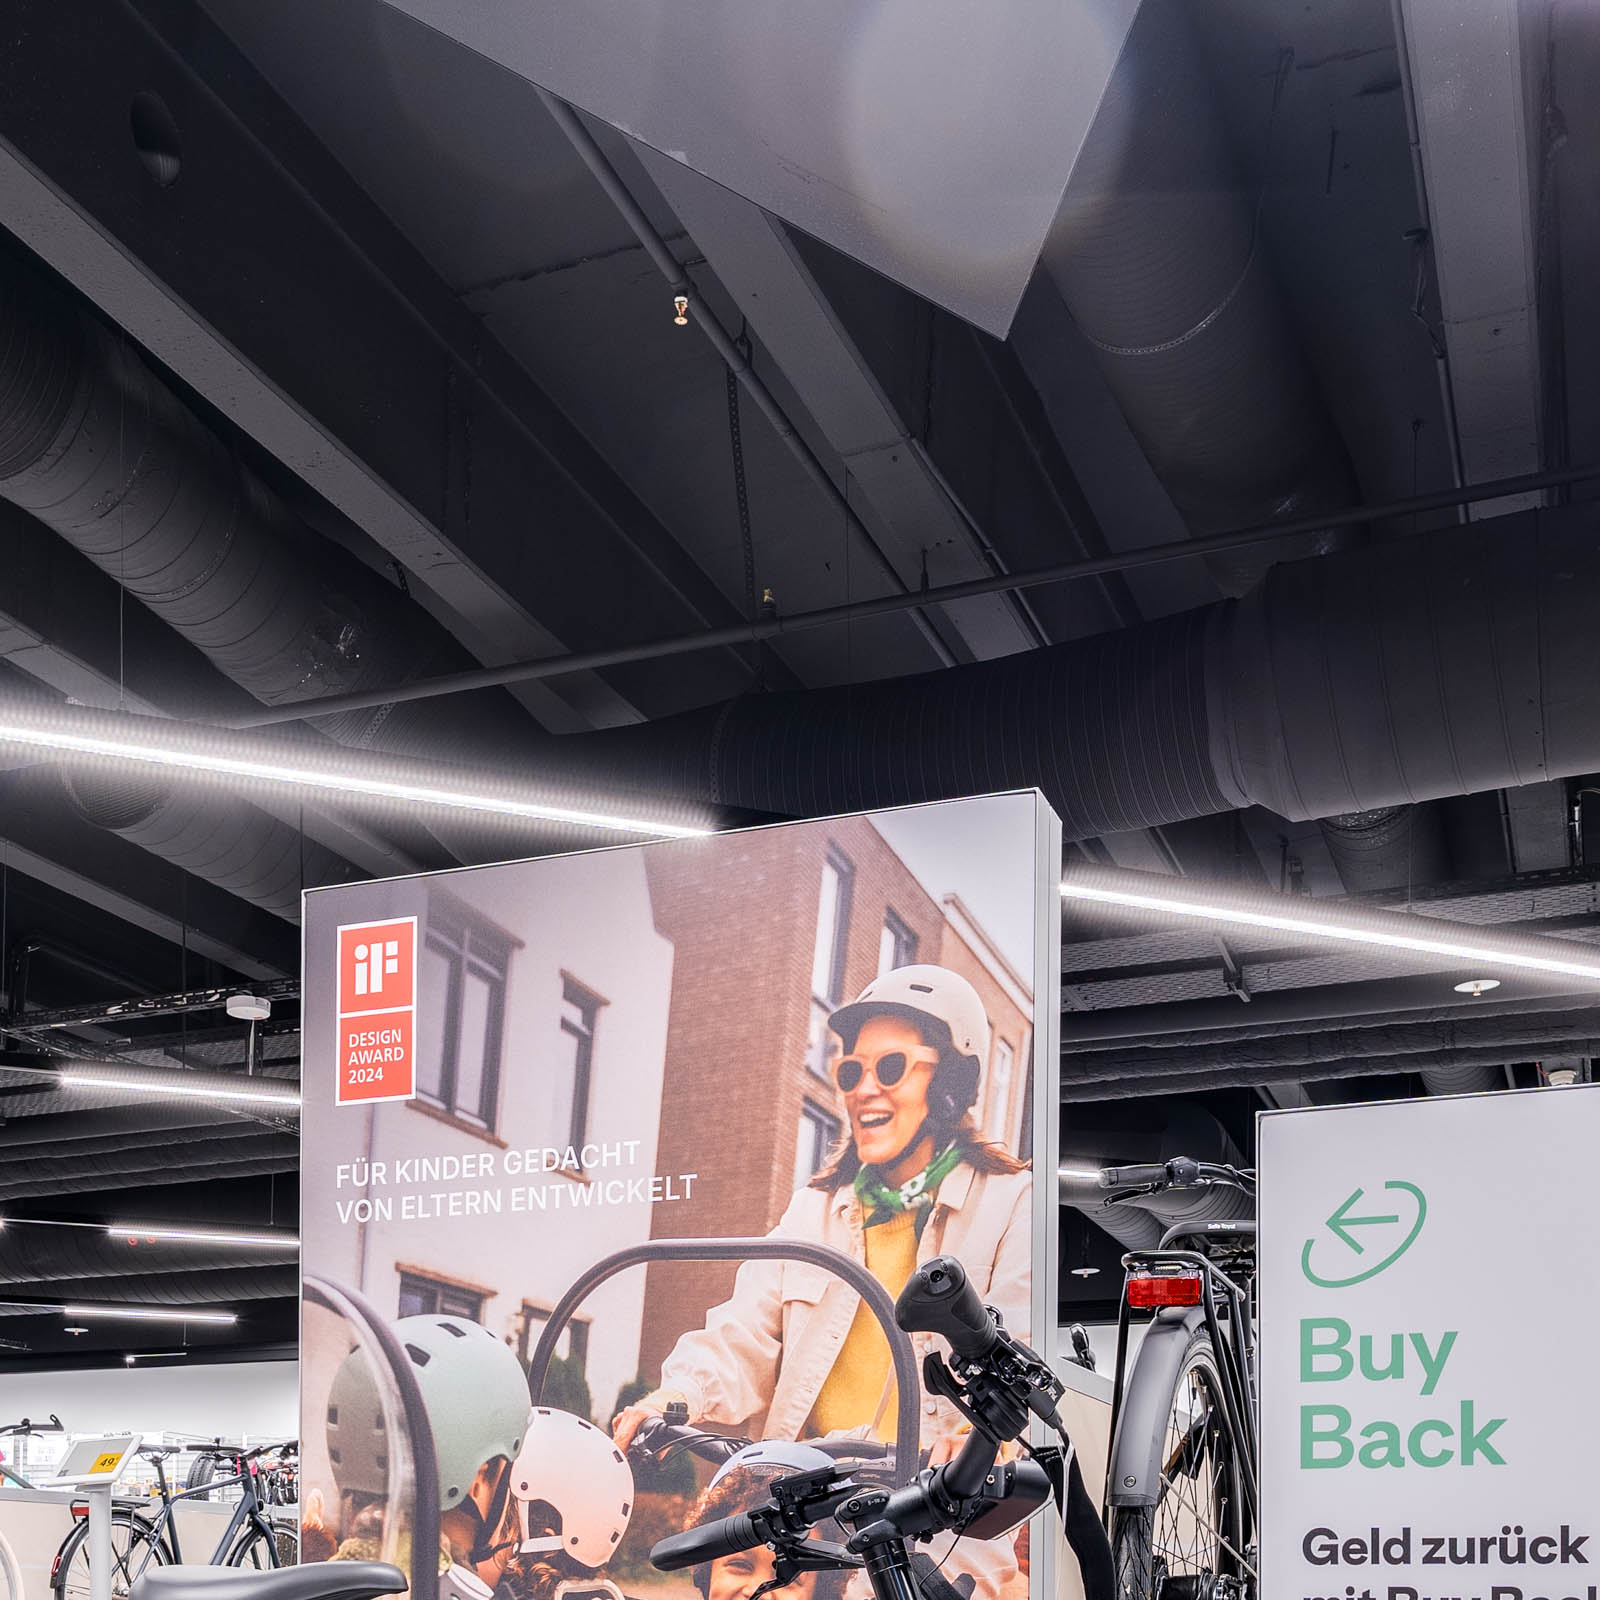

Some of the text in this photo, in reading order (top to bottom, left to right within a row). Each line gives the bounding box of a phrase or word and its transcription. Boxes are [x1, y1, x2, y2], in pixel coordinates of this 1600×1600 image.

[348, 1029, 402, 1048] DESIGN
[348, 1046, 404, 1066] AWARD
[348, 1068, 384, 1084] 2024
[336, 1140, 641, 1189] FÜR KINDER GEDACHT
[335, 1174, 698, 1224] VON ELTERN ENTWICKELT
[1300, 1316, 1459, 1396] Buy
[1300, 1400, 1508, 1470] Back
[1302, 1525, 1590, 1566] Geld zurück
